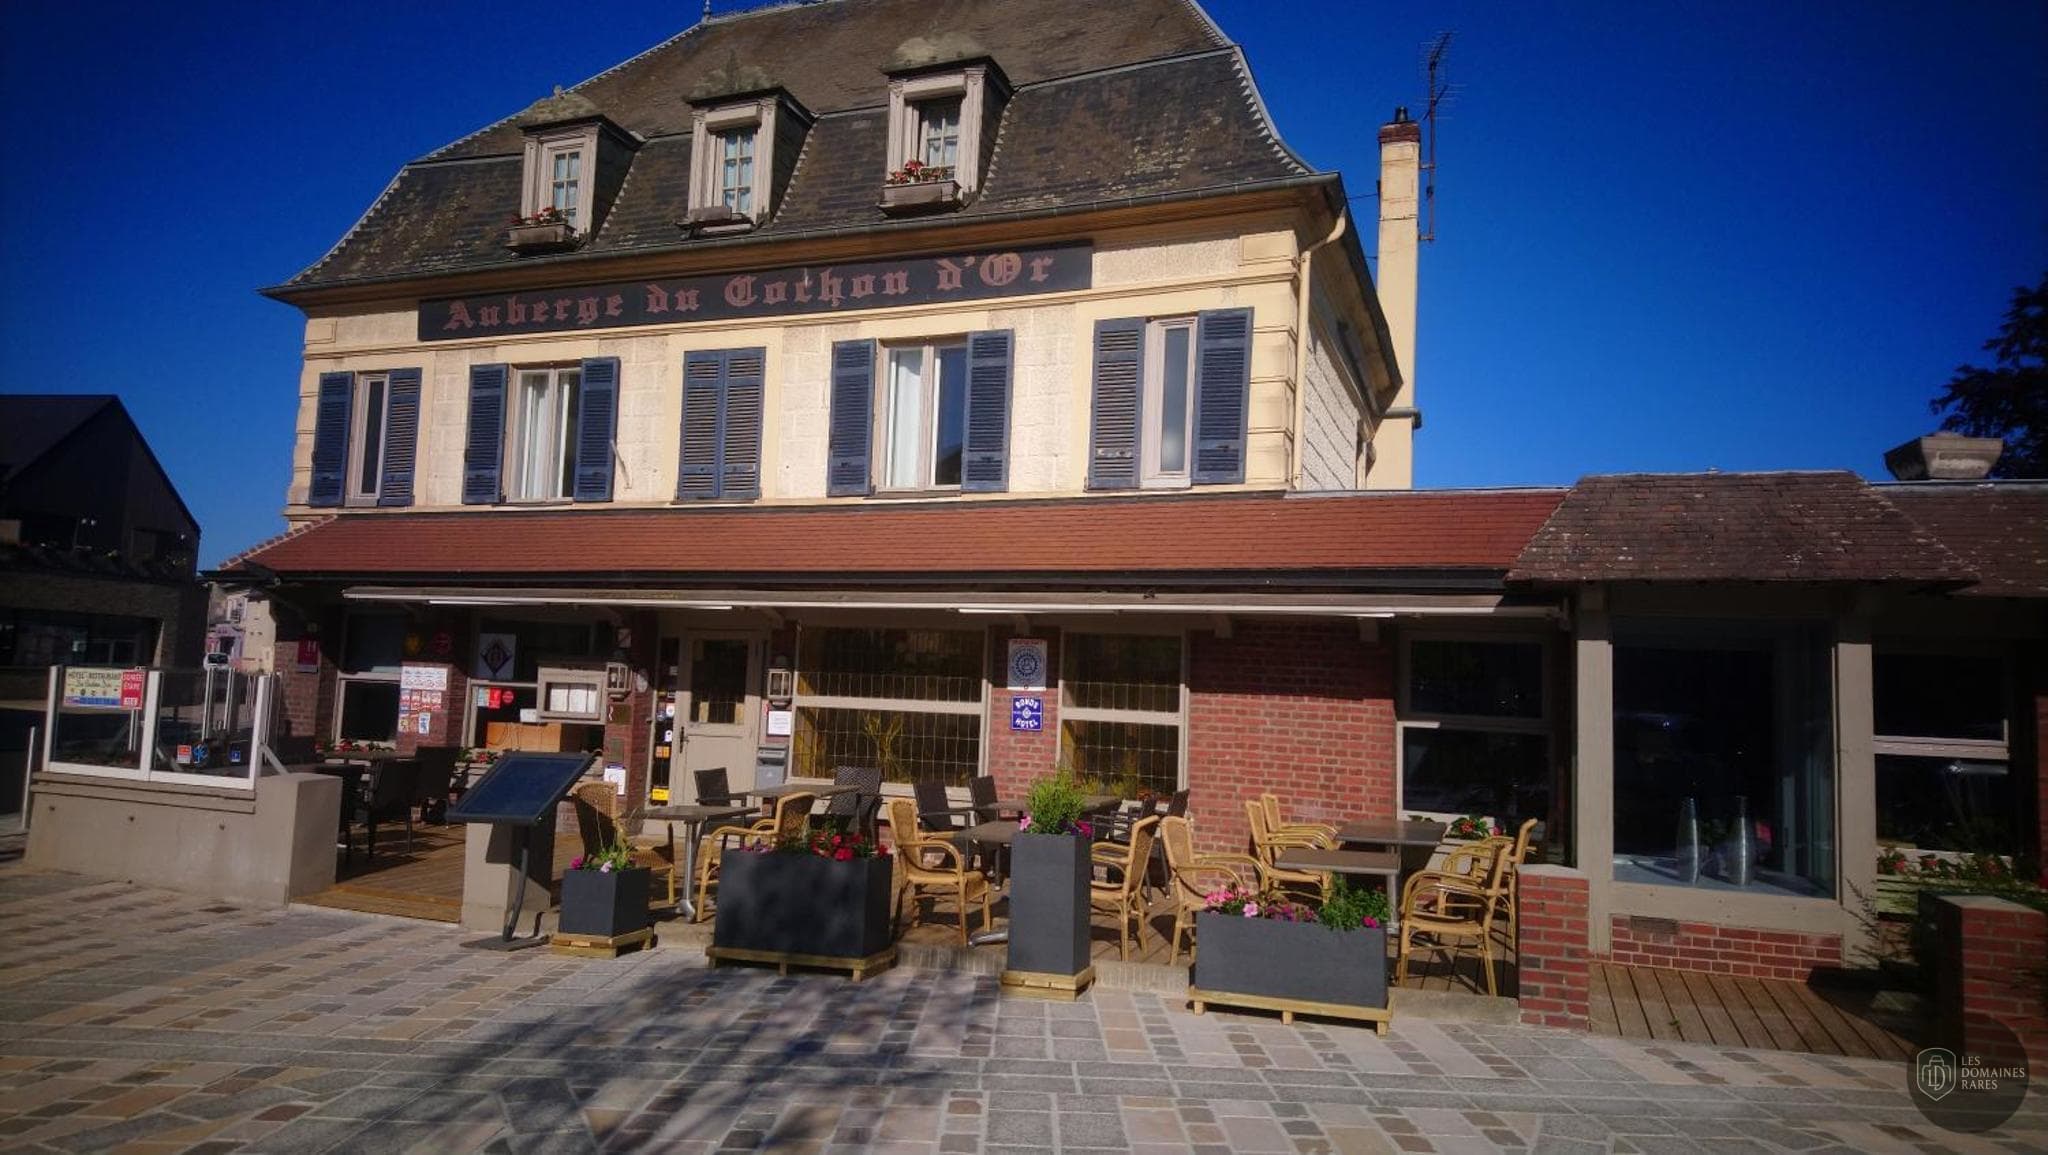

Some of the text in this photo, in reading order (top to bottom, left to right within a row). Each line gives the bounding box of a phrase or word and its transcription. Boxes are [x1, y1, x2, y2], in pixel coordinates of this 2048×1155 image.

[443, 252, 1055, 331] Auberge du Cochon d'Or
